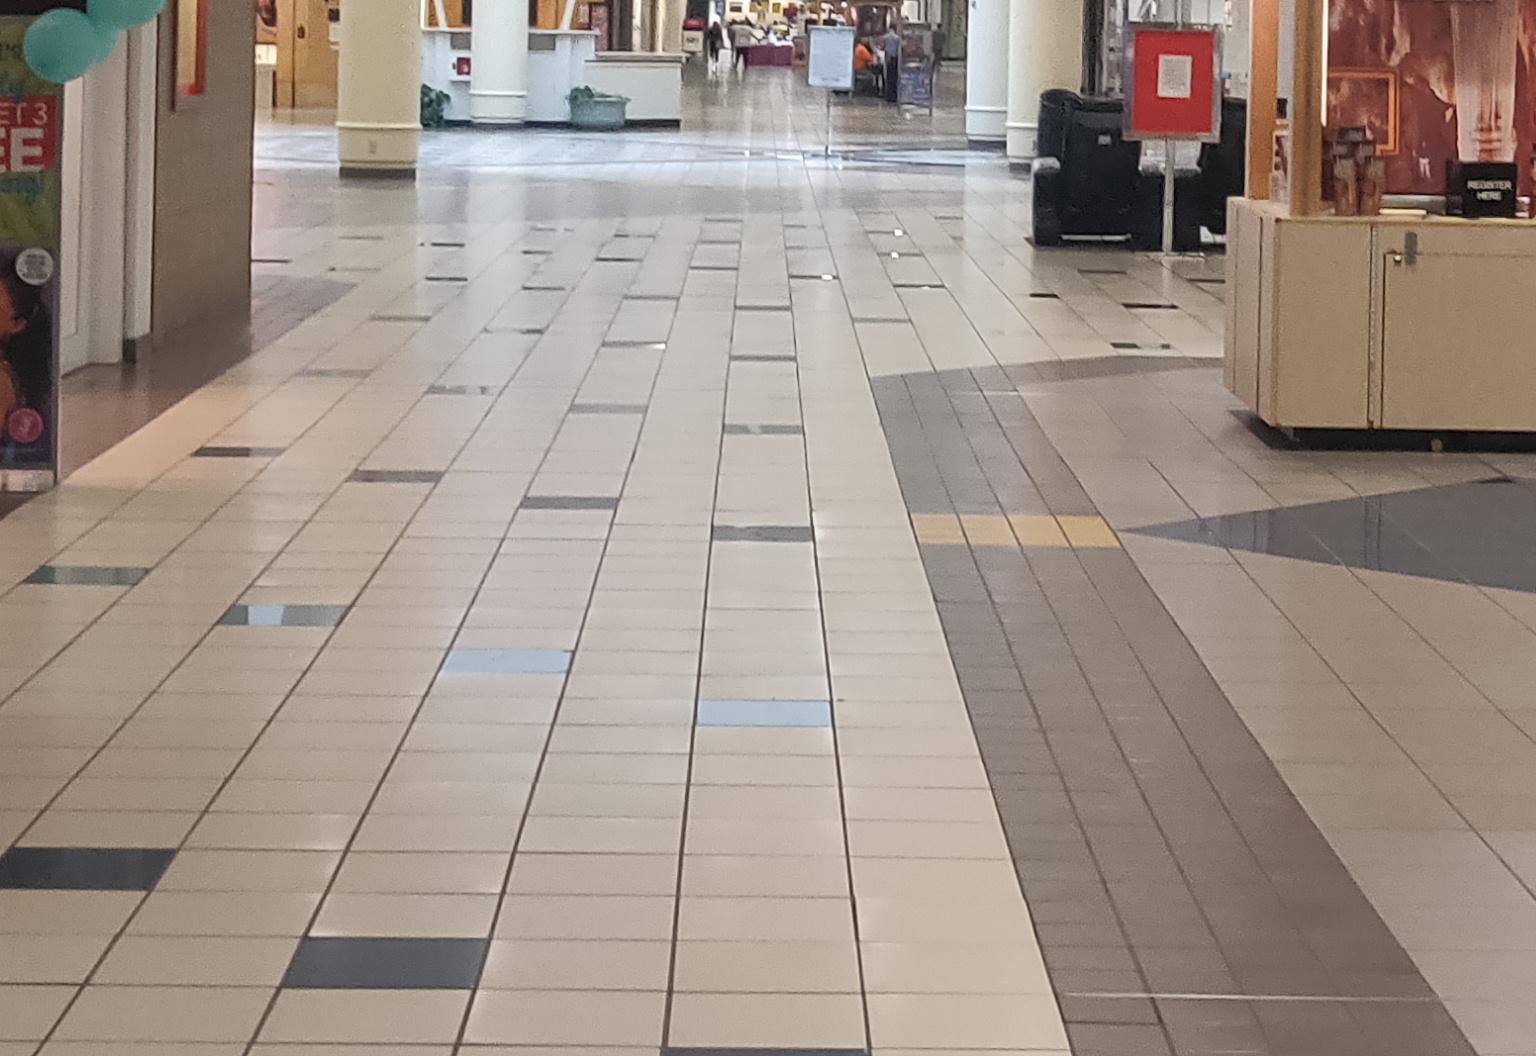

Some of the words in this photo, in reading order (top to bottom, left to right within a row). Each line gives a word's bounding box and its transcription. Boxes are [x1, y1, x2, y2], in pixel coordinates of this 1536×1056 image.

[32, 102, 48, 125] 3
[1467, 180, 1512, 191] REGISTER
[1476, 192, 1502, 201] HERE
